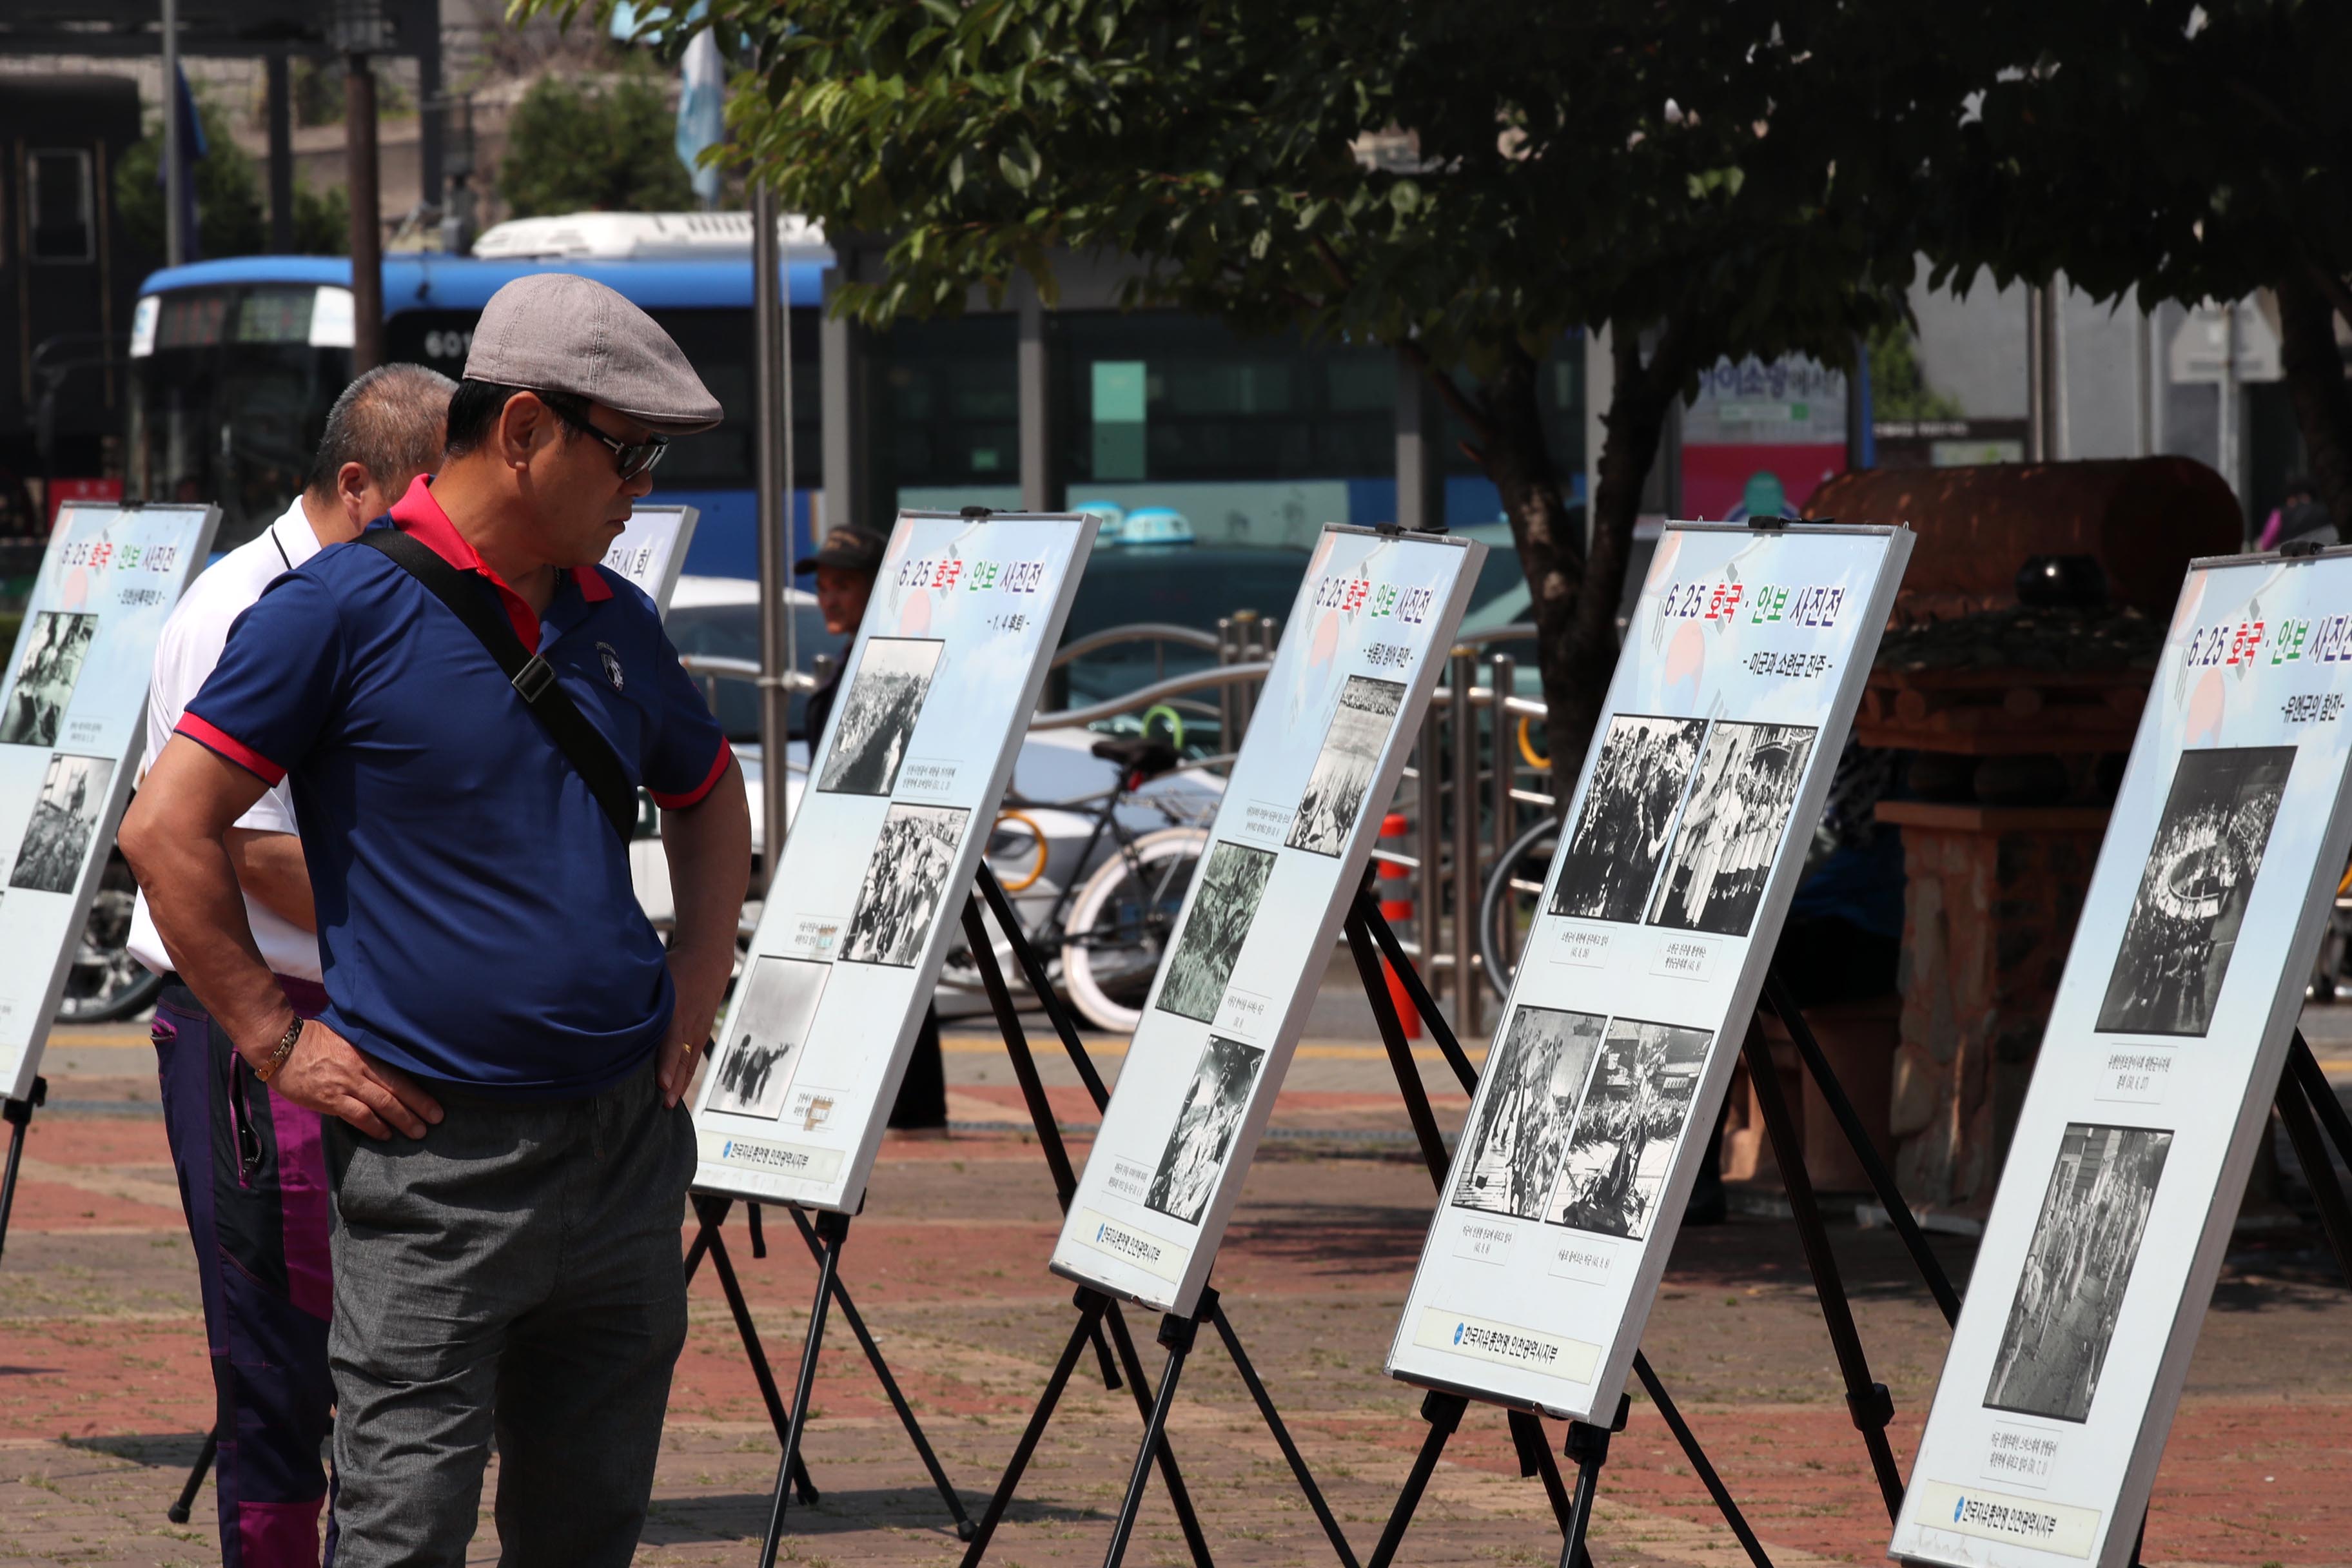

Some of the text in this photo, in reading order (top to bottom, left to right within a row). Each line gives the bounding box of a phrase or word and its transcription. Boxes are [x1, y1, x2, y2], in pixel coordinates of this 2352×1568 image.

[118, 545, 142, 570] 안보
[899, 560, 1044, 593] 6.25 호국 안보 사진전
[1316, 576, 1433, 624] 6.25 호국 안보 사진전
[1665, 583, 1845, 627] 6.25 호국 안보 사진전
[2188, 627, 2229, 667] 6.25
[2226, 622, 2265, 668] 호국
[2271, 619, 2310, 665] 안보
[1749, 651, 1827, 679] 미군과 소련군 진주
[730, 1143, 809, 1170] 한국자유총연맹 인천광역시지부
[1101, 1226, 1161, 1266] 한국자유총연맹 인천광역시지부
[1462, 1326, 1559, 1366] 한국자유총연맹 인천광역시지부
[1963, 1499, 2057, 1539] 한국자유총연맹 인천광역시지부
